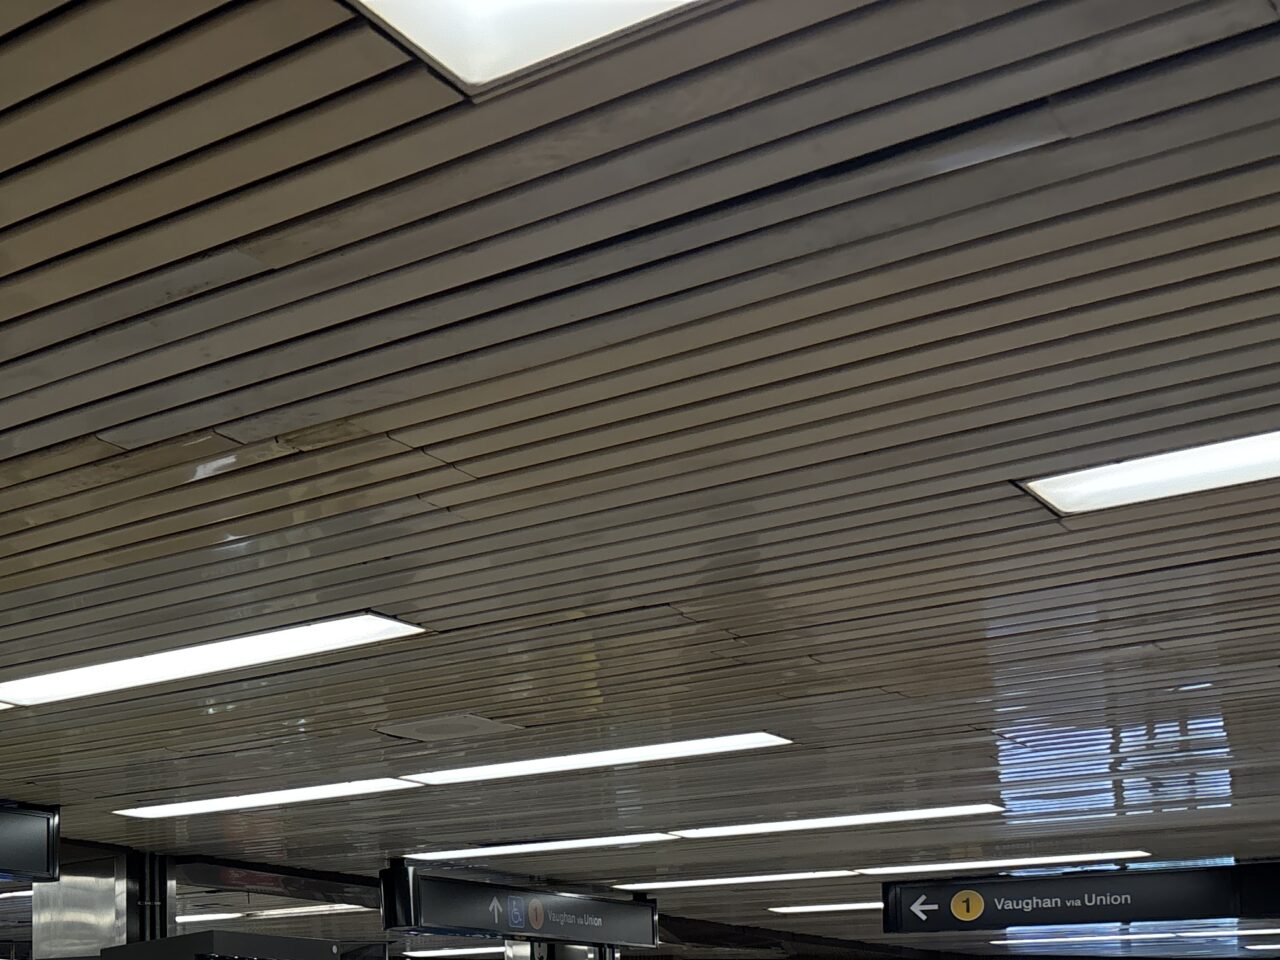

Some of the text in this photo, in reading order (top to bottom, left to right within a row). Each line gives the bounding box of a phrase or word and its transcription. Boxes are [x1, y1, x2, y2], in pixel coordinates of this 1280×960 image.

[994, 895, 1061, 912] Vaughan
[1065, 898, 1082, 908] via
[1084, 892, 1131, 906] Union
[547, 910, 576, 926] Vaughan
[583, 914, 602, 927] Union
